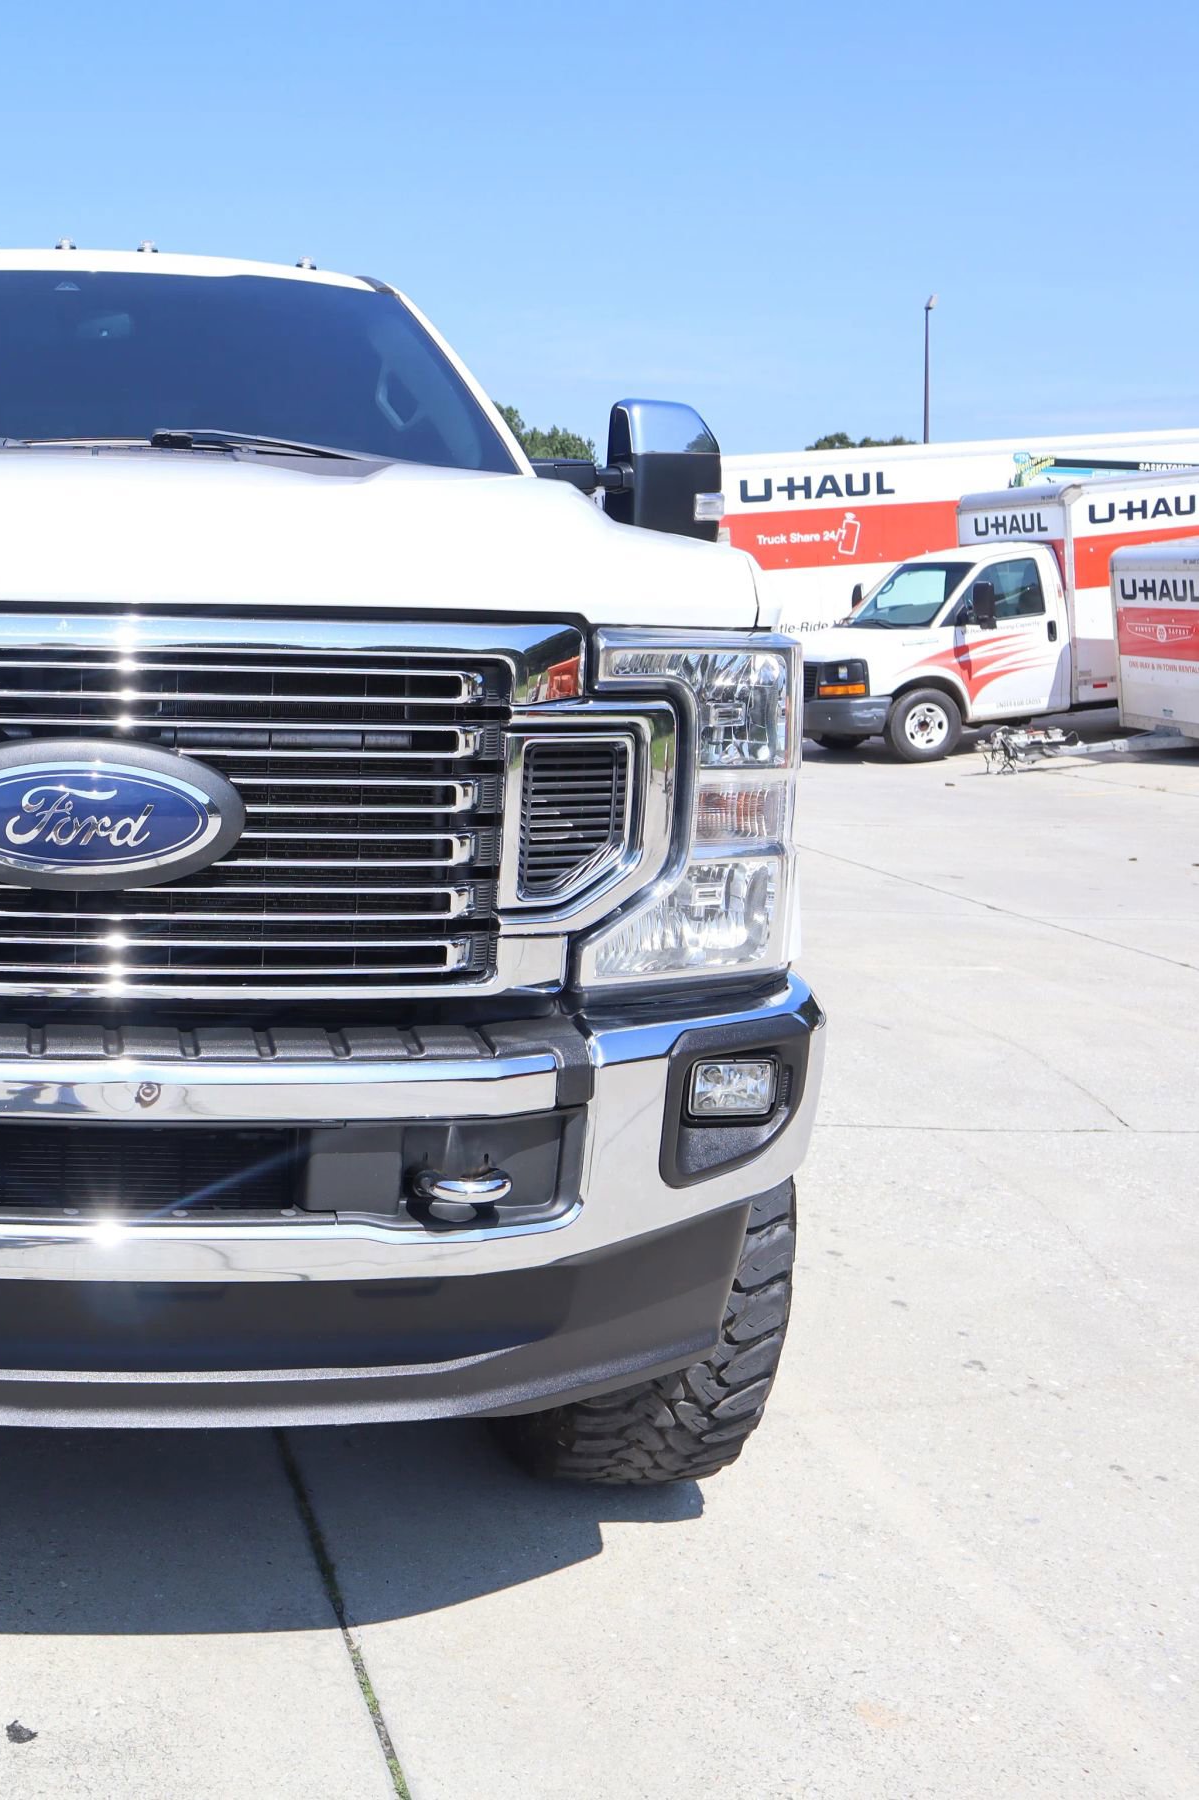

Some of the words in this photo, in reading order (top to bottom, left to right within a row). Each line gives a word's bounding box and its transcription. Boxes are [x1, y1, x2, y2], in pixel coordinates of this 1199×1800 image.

[739, 471, 895, 503] U-HAUL
[756, 533, 788, 545] Truck
[789, 531, 821, 544] Share
[822, 527, 847, 542] 24/7
[974, 512, 1048, 536] U-HAUL
[1120, 578, 1199, 602] U-HAUL
[779, 621, 829, 634] tle-Ride
[1178, 664, 1199, 674] RENTAL
[5, 784, 155, 848] Ford
